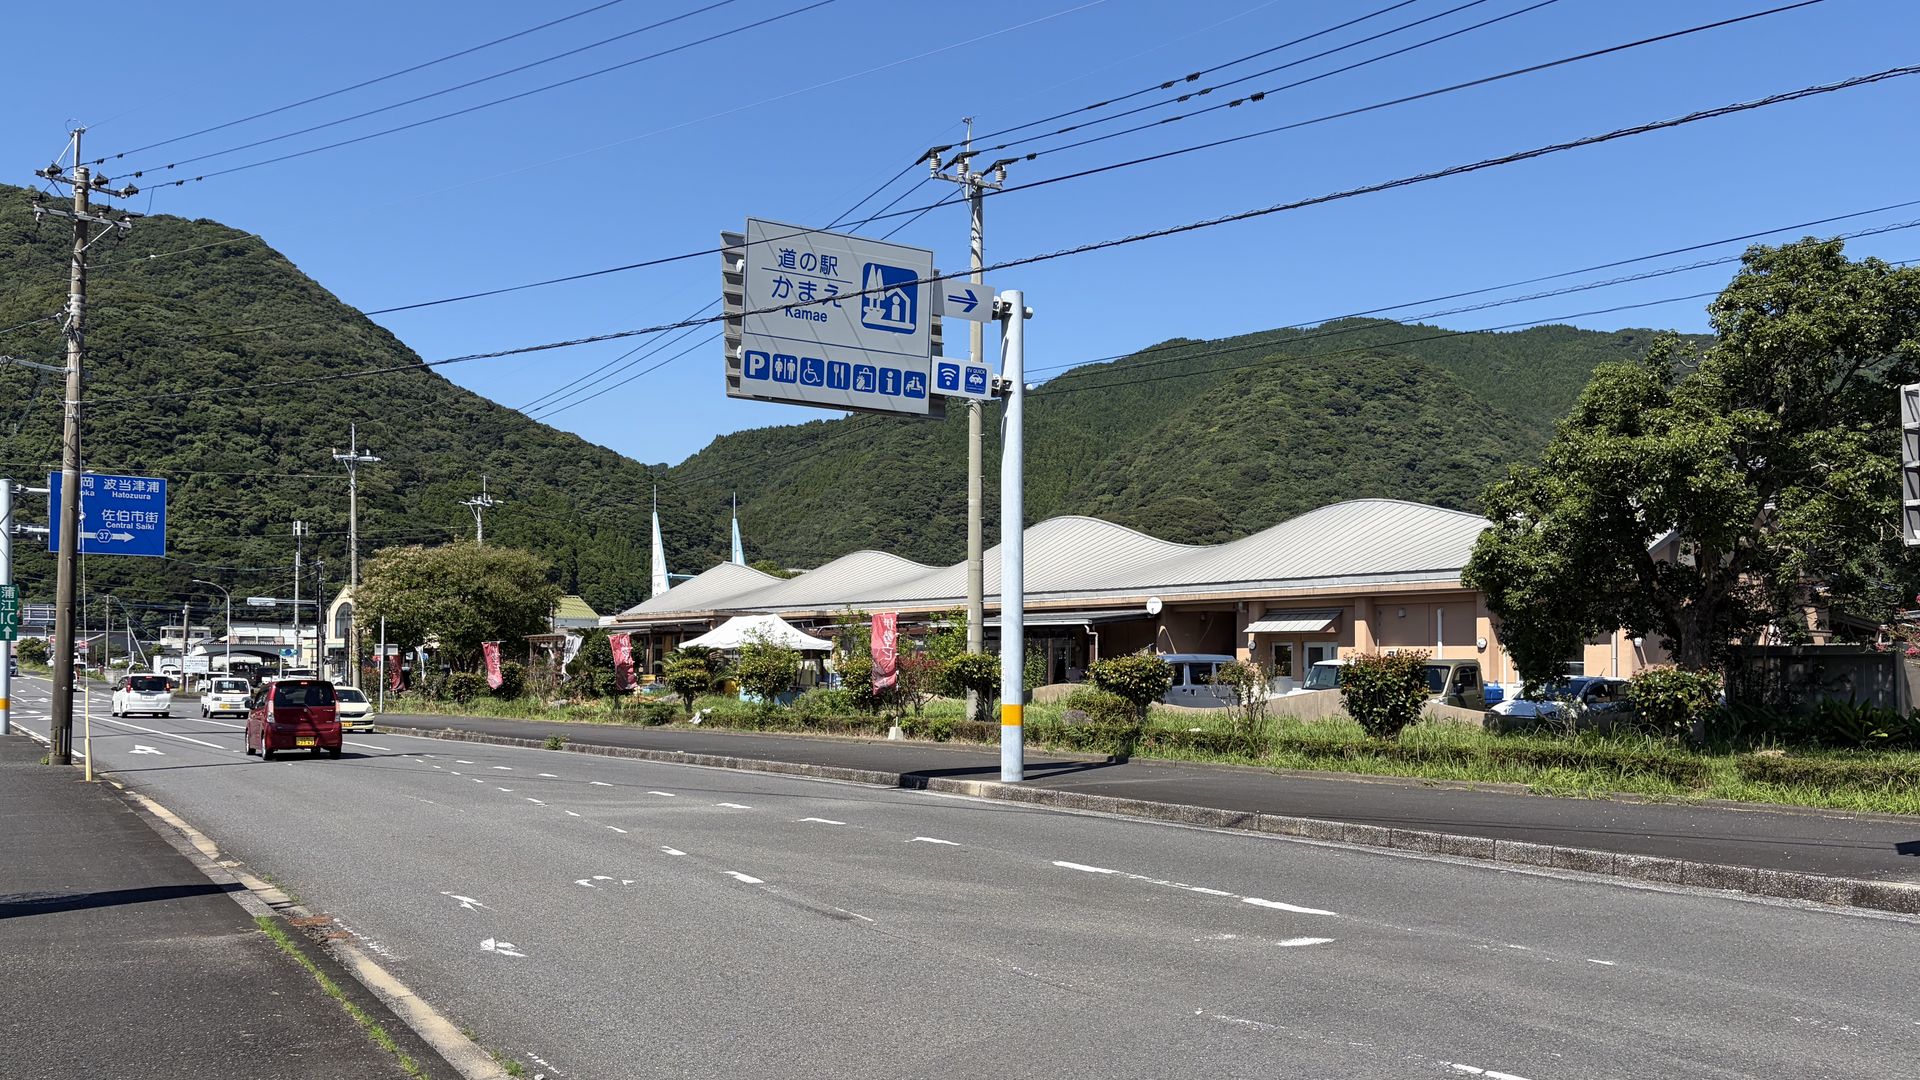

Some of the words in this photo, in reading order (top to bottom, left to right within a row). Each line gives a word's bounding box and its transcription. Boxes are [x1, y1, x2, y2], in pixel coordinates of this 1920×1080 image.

[778, 248, 838, 276] 道の駅
[772, 275, 841, 307] かまえ
[785, 306, 828, 322] Kamae
[749, 354, 765, 376] P
[81, 476, 94, 489] 岡
[103, 478, 160, 493] 波当津浦
[112, 491, 151, 500] Hatozuura
[101, 509, 159, 524] 佐伯市街
[105, 521, 133, 529] Central
[135, 522, 155, 530] Saiki
[99, 532, 109, 540] 37
